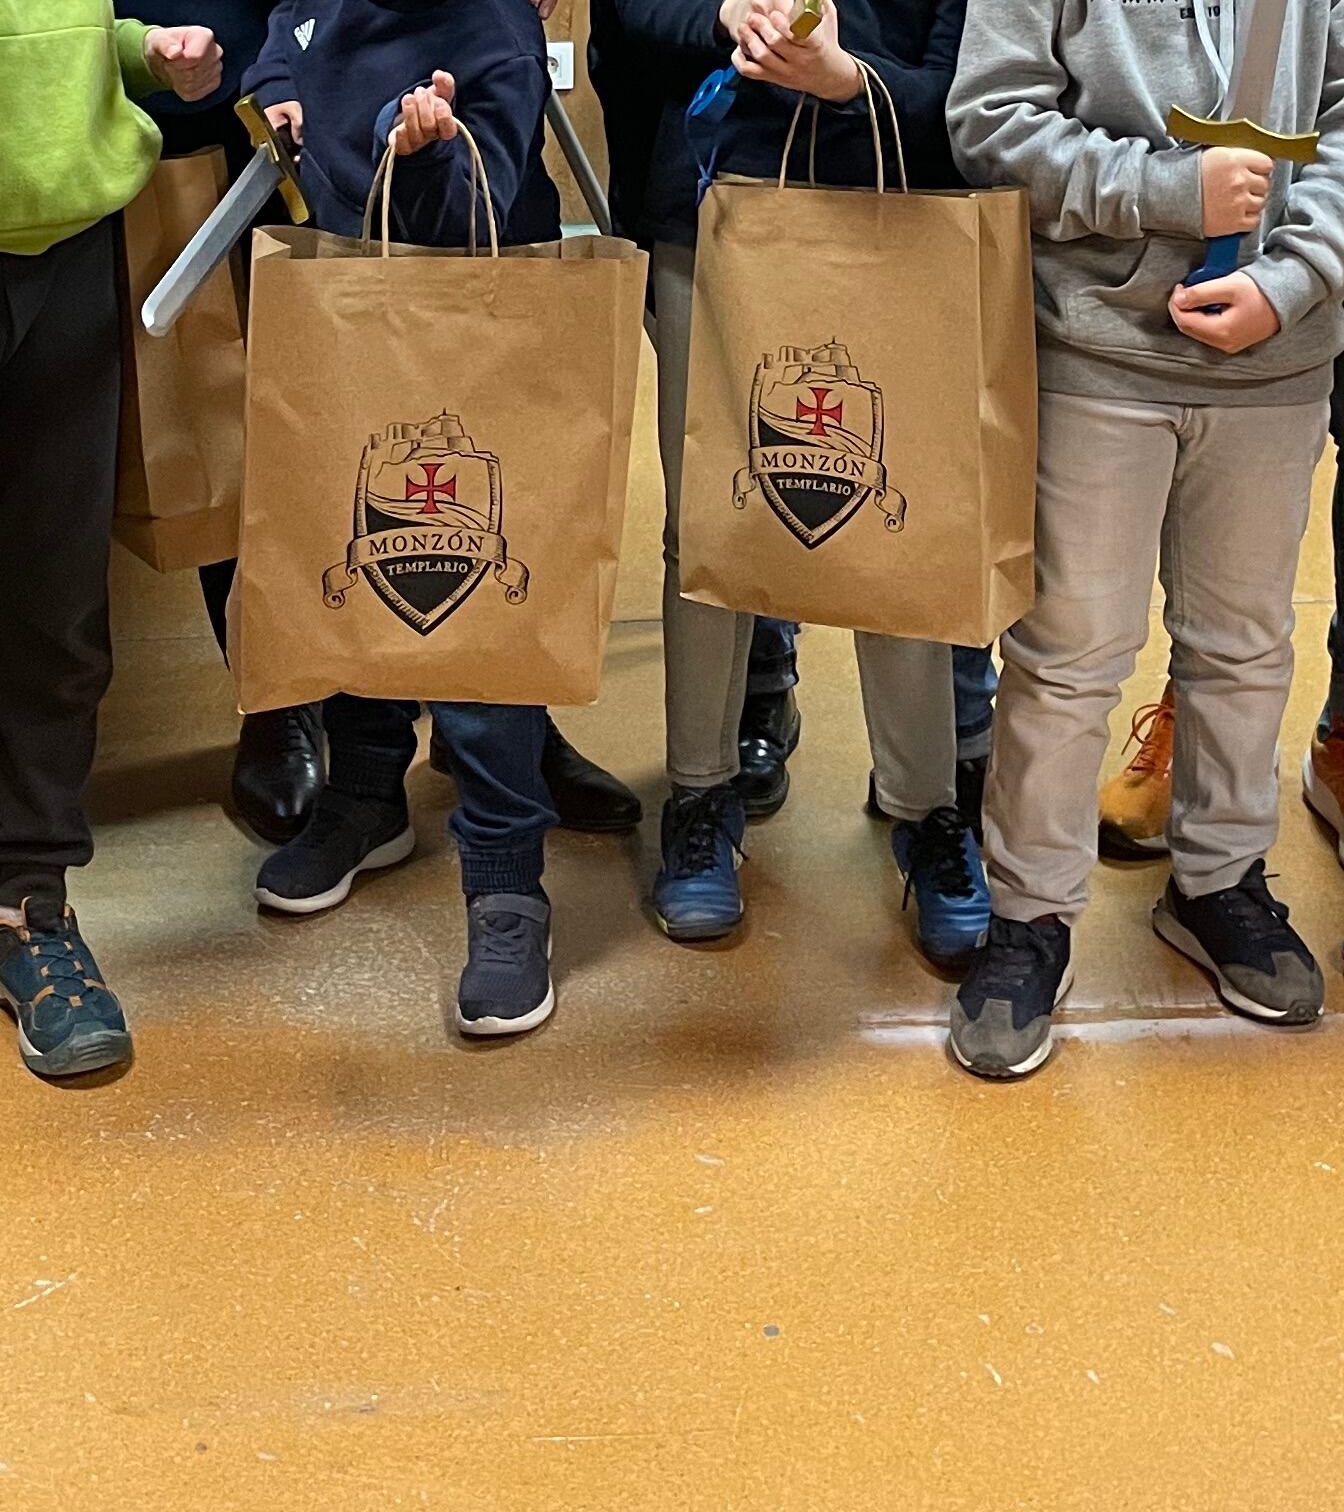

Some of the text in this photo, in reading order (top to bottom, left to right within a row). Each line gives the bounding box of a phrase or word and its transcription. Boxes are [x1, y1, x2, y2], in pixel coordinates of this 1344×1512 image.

[760, 451, 867, 477] MONZÓN
[775, 478, 852, 497] TEMPLARIO
[368, 529, 485, 556] MONZÓN
[386, 560, 469, 576] TEMPLARIO
